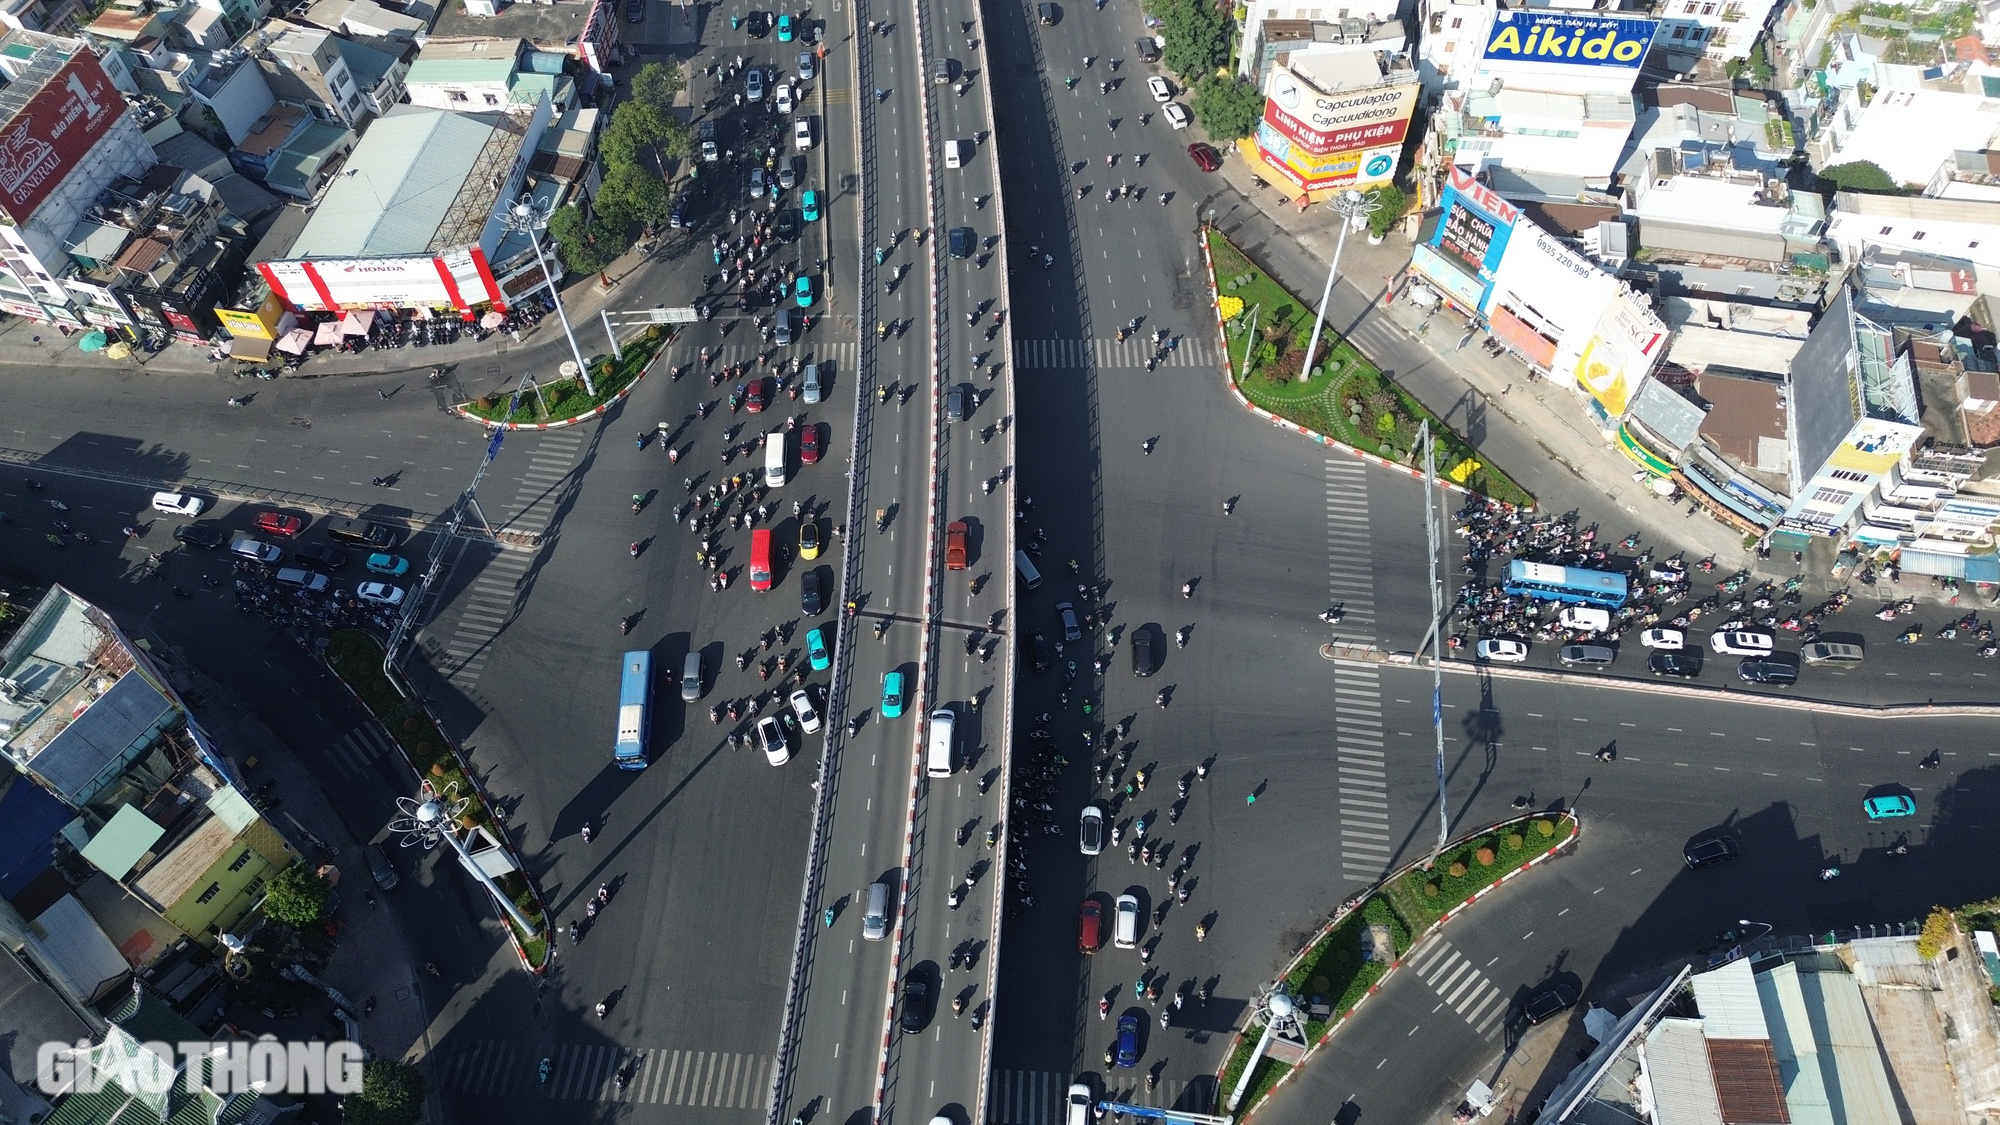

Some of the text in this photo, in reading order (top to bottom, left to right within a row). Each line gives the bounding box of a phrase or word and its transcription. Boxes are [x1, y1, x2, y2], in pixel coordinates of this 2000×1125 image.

[1535, 17, 1618, 29] MIẾNG DÁN HẠ SỐT
[1487, 25, 1642, 62] Aikido
[66, 71, 101, 121] 1
[1316, 91, 1402, 112] Capcuulaptop
[51, 123, 67, 140] BẢO
[66, 102, 84, 127] HIỂM
[1275, 108, 1298, 131] LINH
[1298, 126, 1326, 146] KIỆN
[1335, 131, 1363, 143] PHỤ
[1363, 124, 1394, 139] KIỆN
[1312, 106, 1398, 128] Capcuudidong
[1292, 134, 1311, 149] LAPTOP
[1313, 145, 1329, 154] ĐIỆN
[1329, 143, 1349, 152] THOẠI
[13, 152, 62, 206] GENERALI
[1450, 161, 1518, 224] VIỆN
[1446, 217, 1465, 236] BẢO
[1466, 229, 1489, 251] HÀNH
[1451, 204, 1494, 240] SỬA CHỮA
[1536, 238, 1590, 279] 0935 220 999
[184, 276, 202, 301] COUPLE
[1620, 280, 1665, 330] Enchanteur
[1641, 332, 1662, 357] 1
